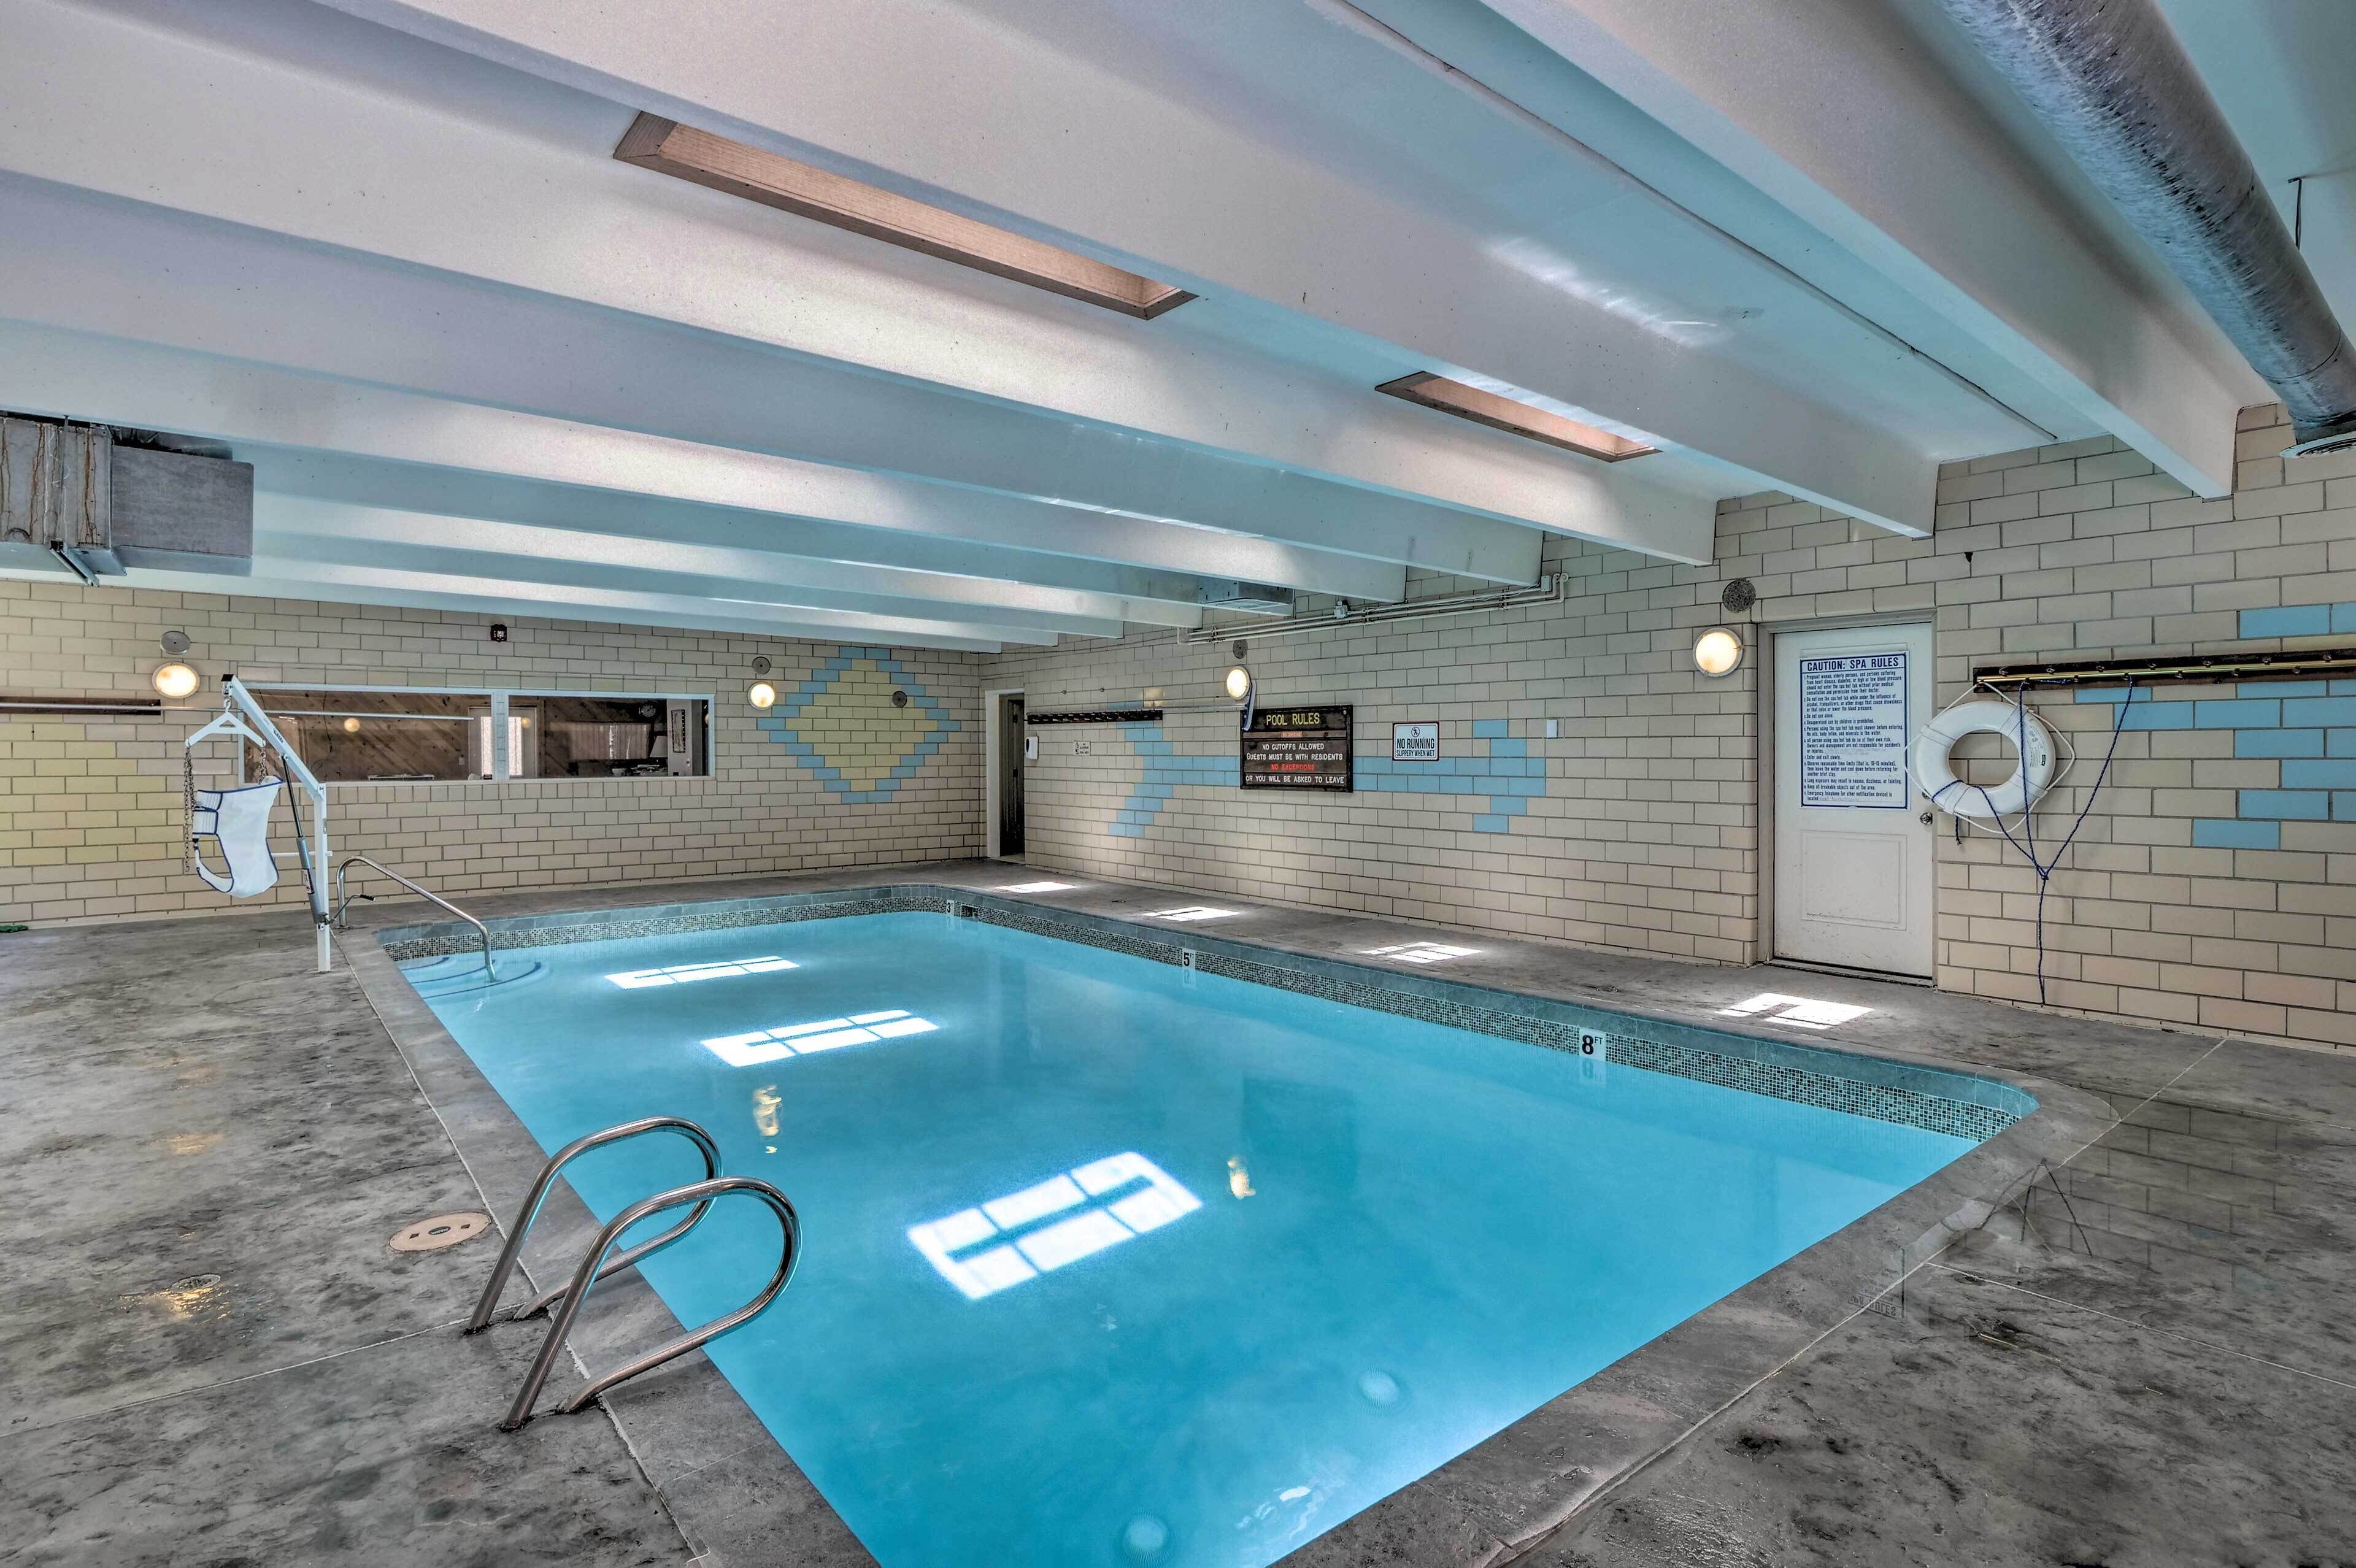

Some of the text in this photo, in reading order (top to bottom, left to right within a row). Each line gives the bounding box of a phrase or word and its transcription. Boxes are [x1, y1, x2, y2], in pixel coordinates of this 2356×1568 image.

[1807, 657, 1898, 671] CAUTION: SPA RULES
[1266, 712, 1320, 726] POOL RULES
[1396, 738, 1434, 749] NO RUNNING
[947, 902, 951, 913] 3
[1184, 952, 1190, 967] 5
[1582, 1034, 1603, 1055] 8 FT
